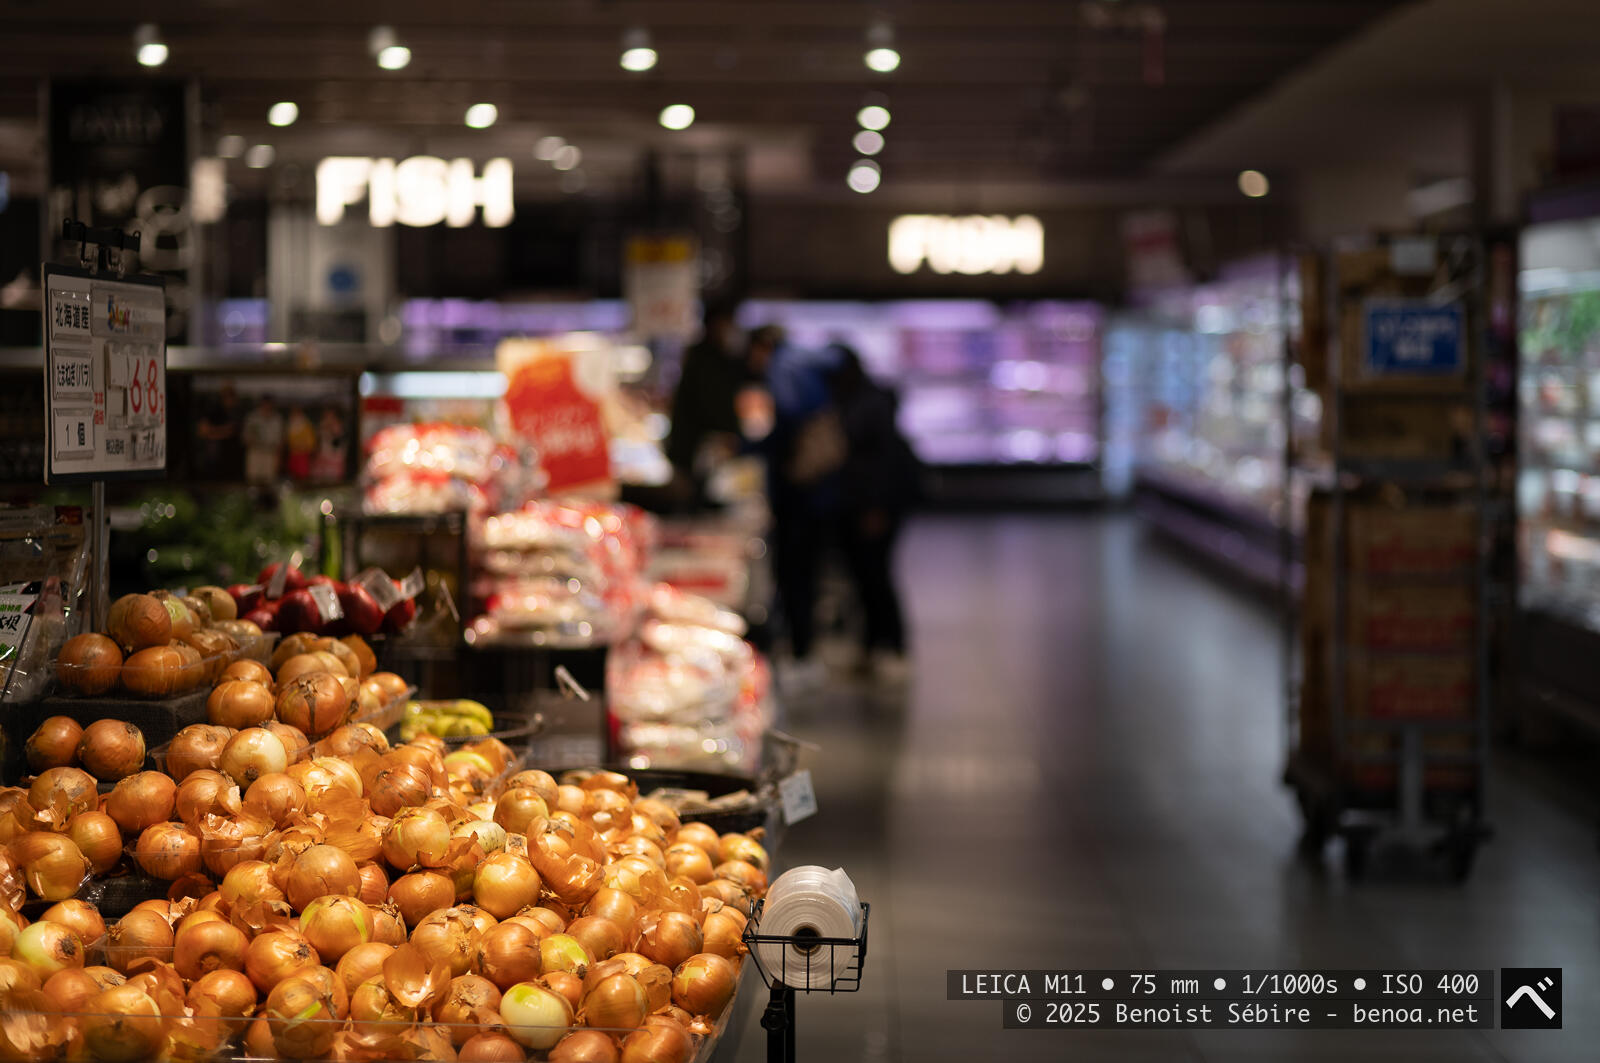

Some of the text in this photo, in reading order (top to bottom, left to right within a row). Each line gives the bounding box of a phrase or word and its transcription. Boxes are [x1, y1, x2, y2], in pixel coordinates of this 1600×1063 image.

[55, 303, 89, 329] 北海道産
[131, 358, 159, 414] 68
